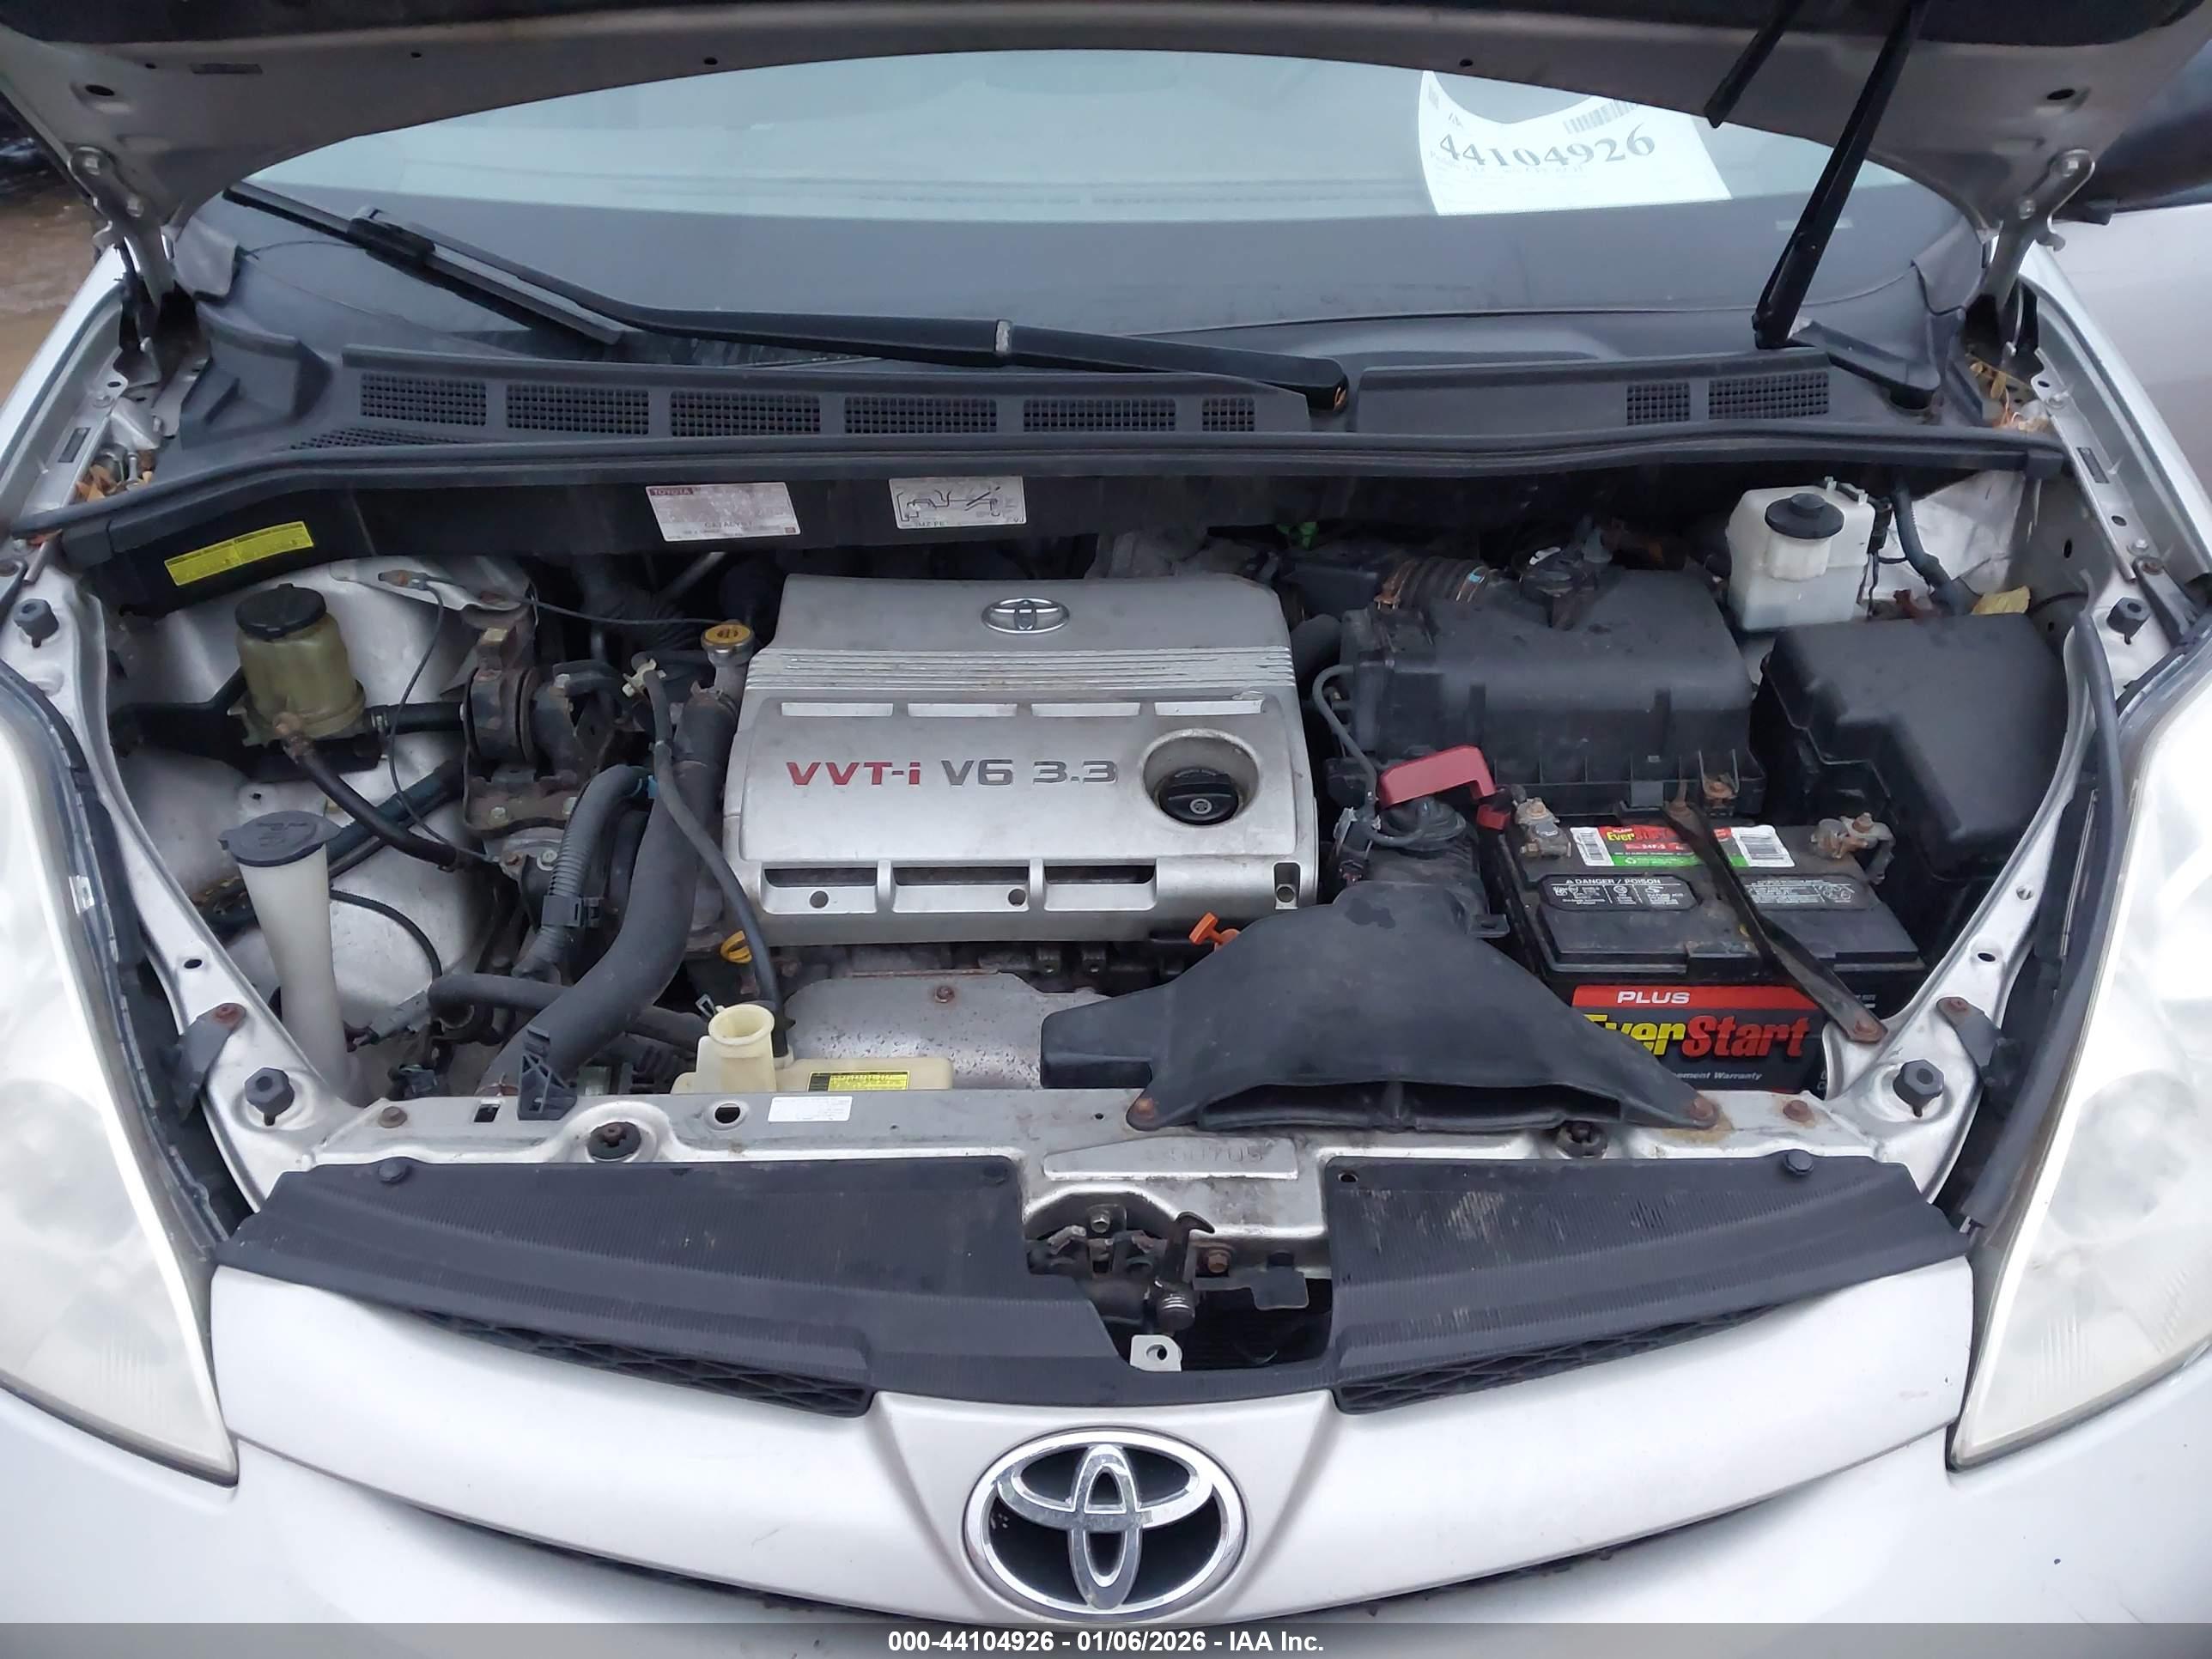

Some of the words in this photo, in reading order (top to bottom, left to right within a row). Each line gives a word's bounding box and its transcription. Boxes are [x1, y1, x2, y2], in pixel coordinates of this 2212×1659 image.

[1440, 122, 1656, 167] 44104926
[653, 488, 693, 496] TOYOTA
[786, 761, 921, 786] VVT-i
[941, 759, 1014, 786] V6
[1032, 760, 1117, 784] 3.3
[1617, 990, 1691, 1004] PLUS
[1714, 1072, 1762, 1080] Warranty
